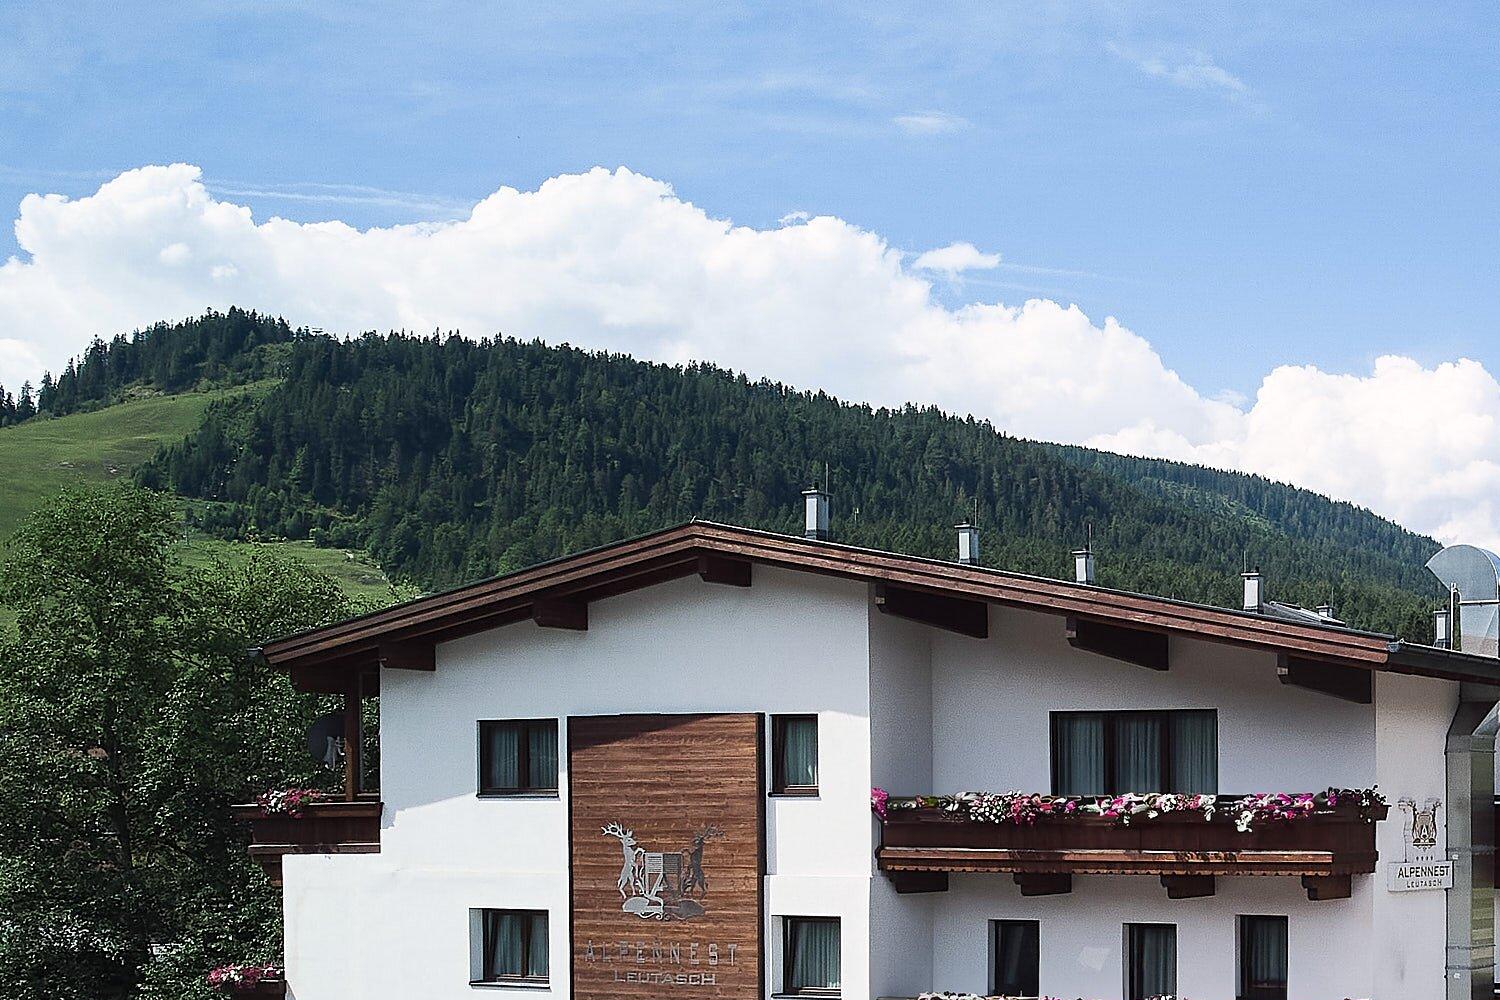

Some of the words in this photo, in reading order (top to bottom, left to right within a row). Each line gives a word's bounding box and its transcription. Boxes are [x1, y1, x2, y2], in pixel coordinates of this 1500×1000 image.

[1397, 865, 1450, 878] ALPENNEST
[1406, 879, 1442, 888] LEUTASCH
[585, 939, 738, 966] ALPENNEST
[614, 970, 716, 985] LEUTASCH
